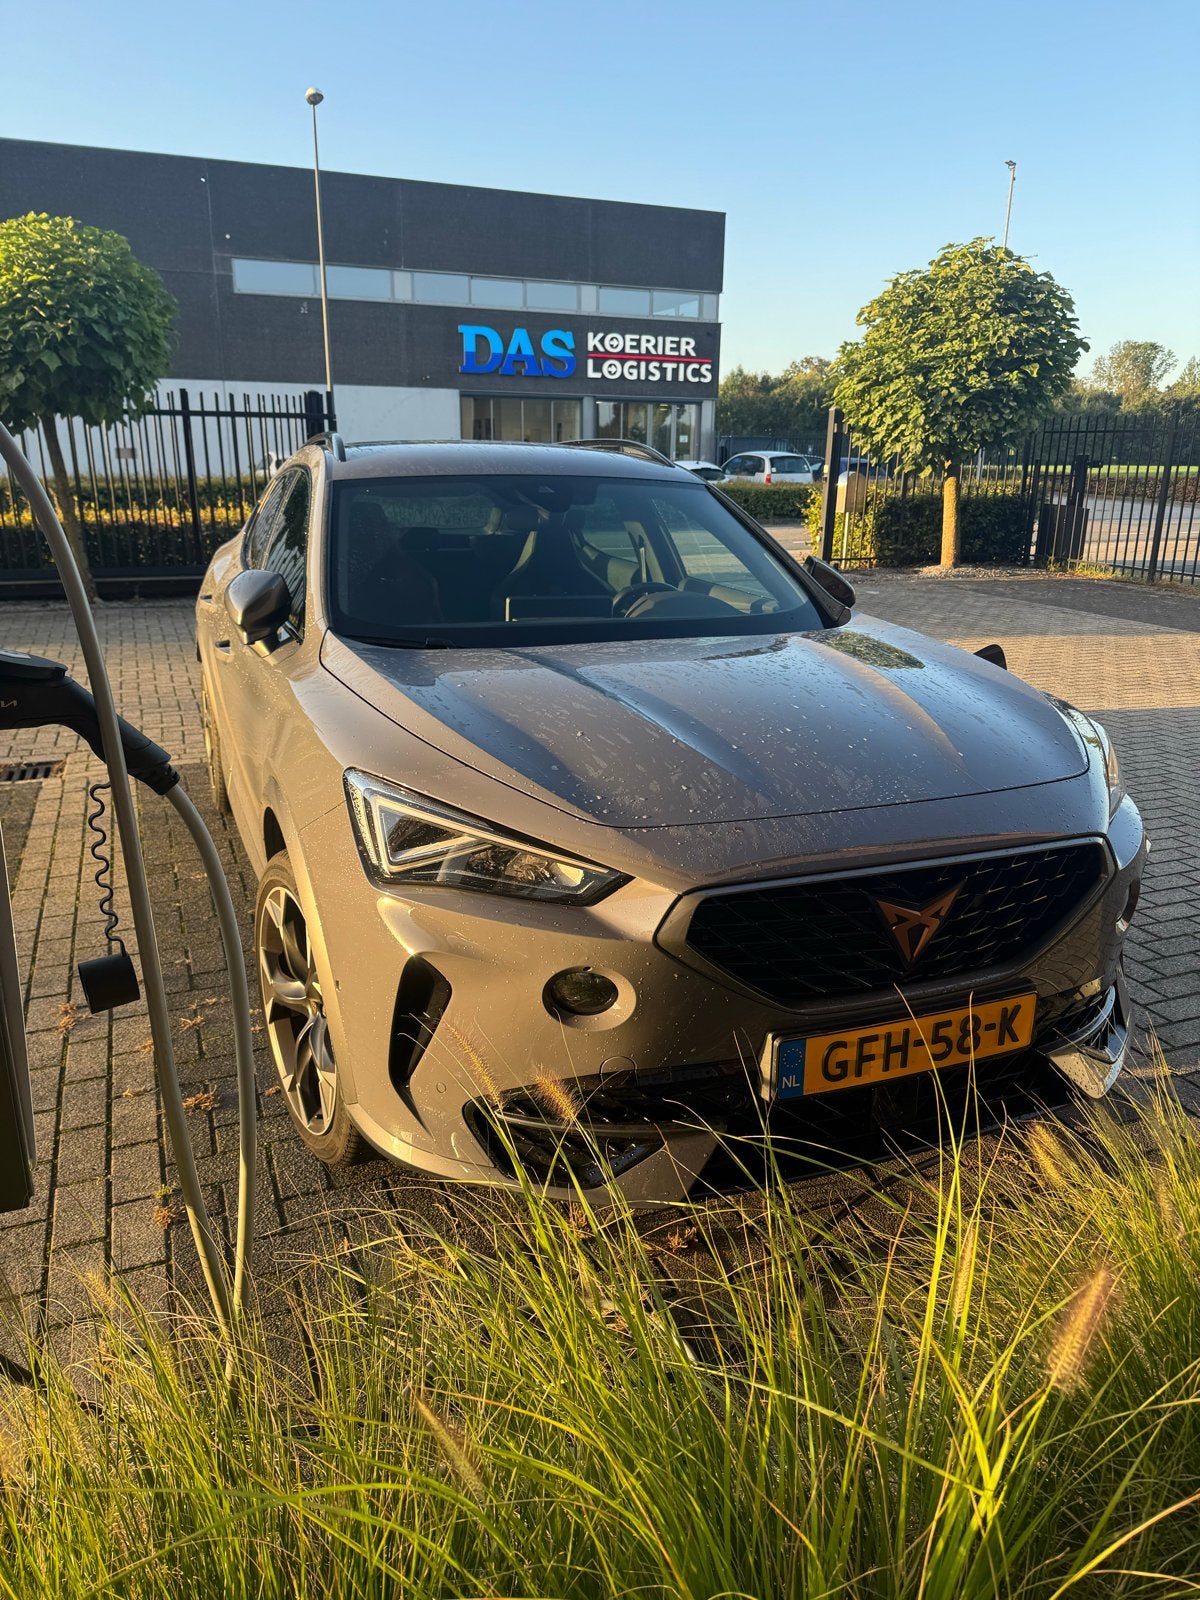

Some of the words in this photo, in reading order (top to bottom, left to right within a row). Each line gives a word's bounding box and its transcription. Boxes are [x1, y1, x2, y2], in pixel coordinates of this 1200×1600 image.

[458, 325, 576, 378] DAS
[587, 332, 696, 356] KOERIER
[587, 358, 712, 383] LOGISTICS
[782, 1075, 800, 1089] NL
[821, 1004, 1022, 1082] GFH-58-K
